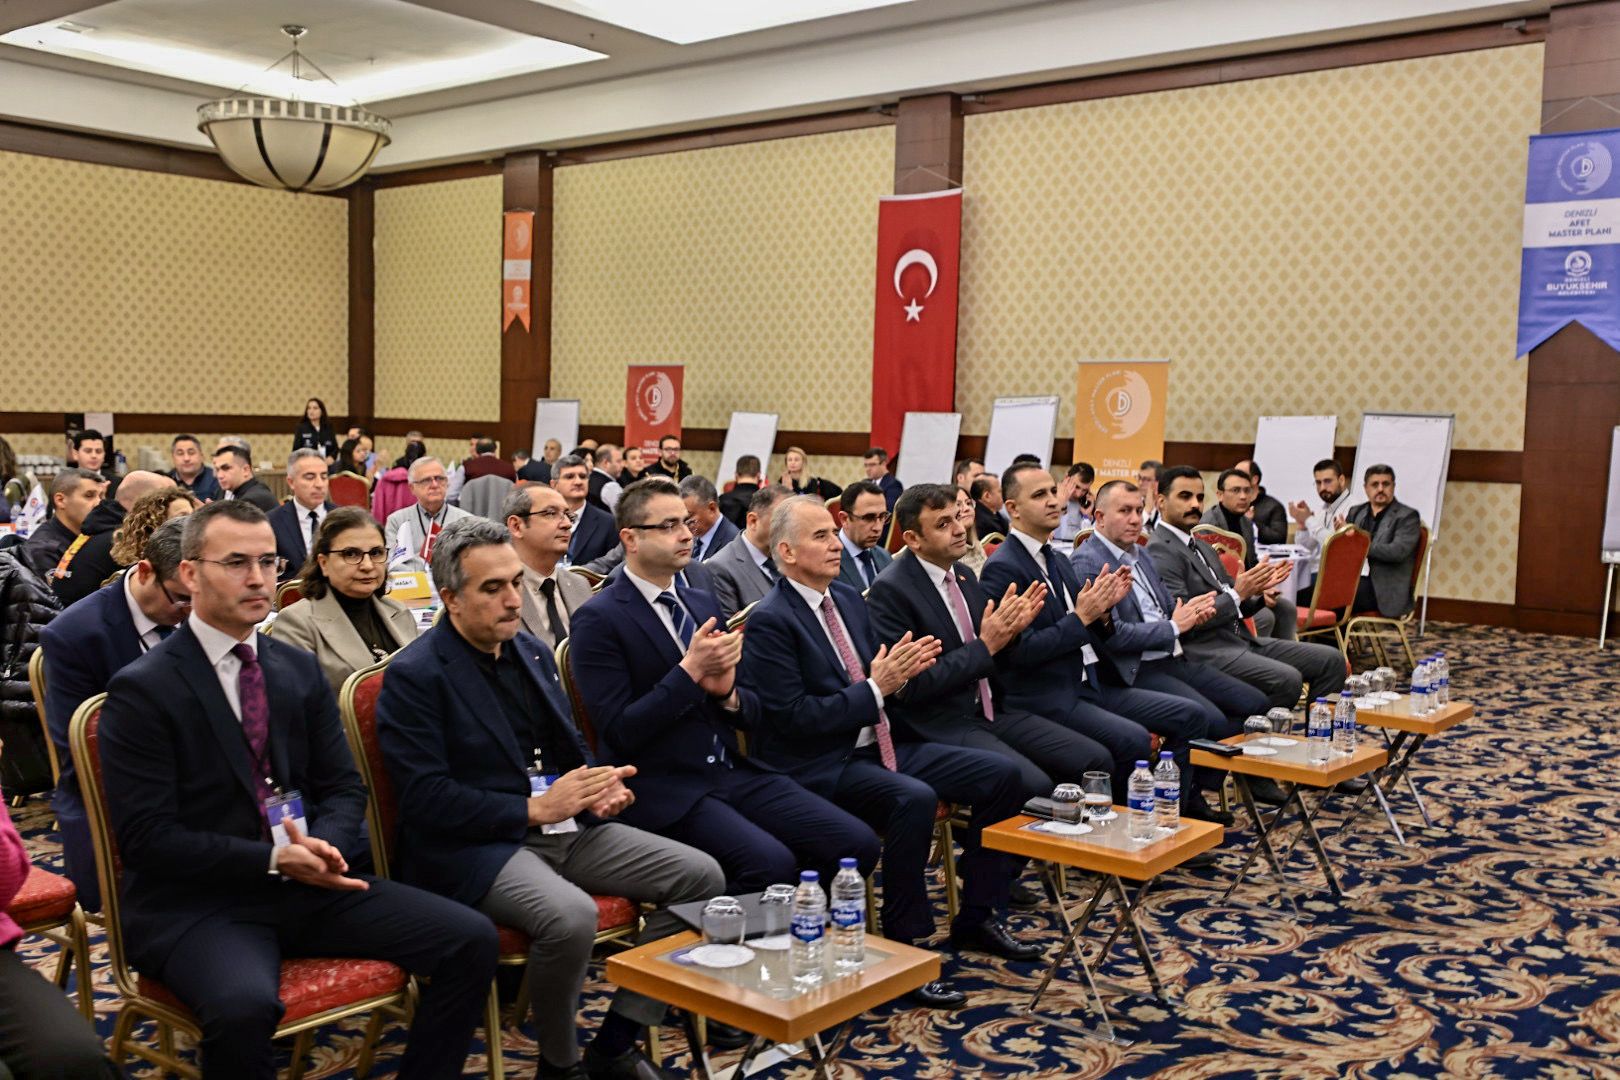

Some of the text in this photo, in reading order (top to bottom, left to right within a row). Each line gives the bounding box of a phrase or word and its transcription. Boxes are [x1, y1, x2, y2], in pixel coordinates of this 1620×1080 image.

[1569, 218, 1591, 227] AFET
[1548, 227, 1612, 238] MASTER PLANI
